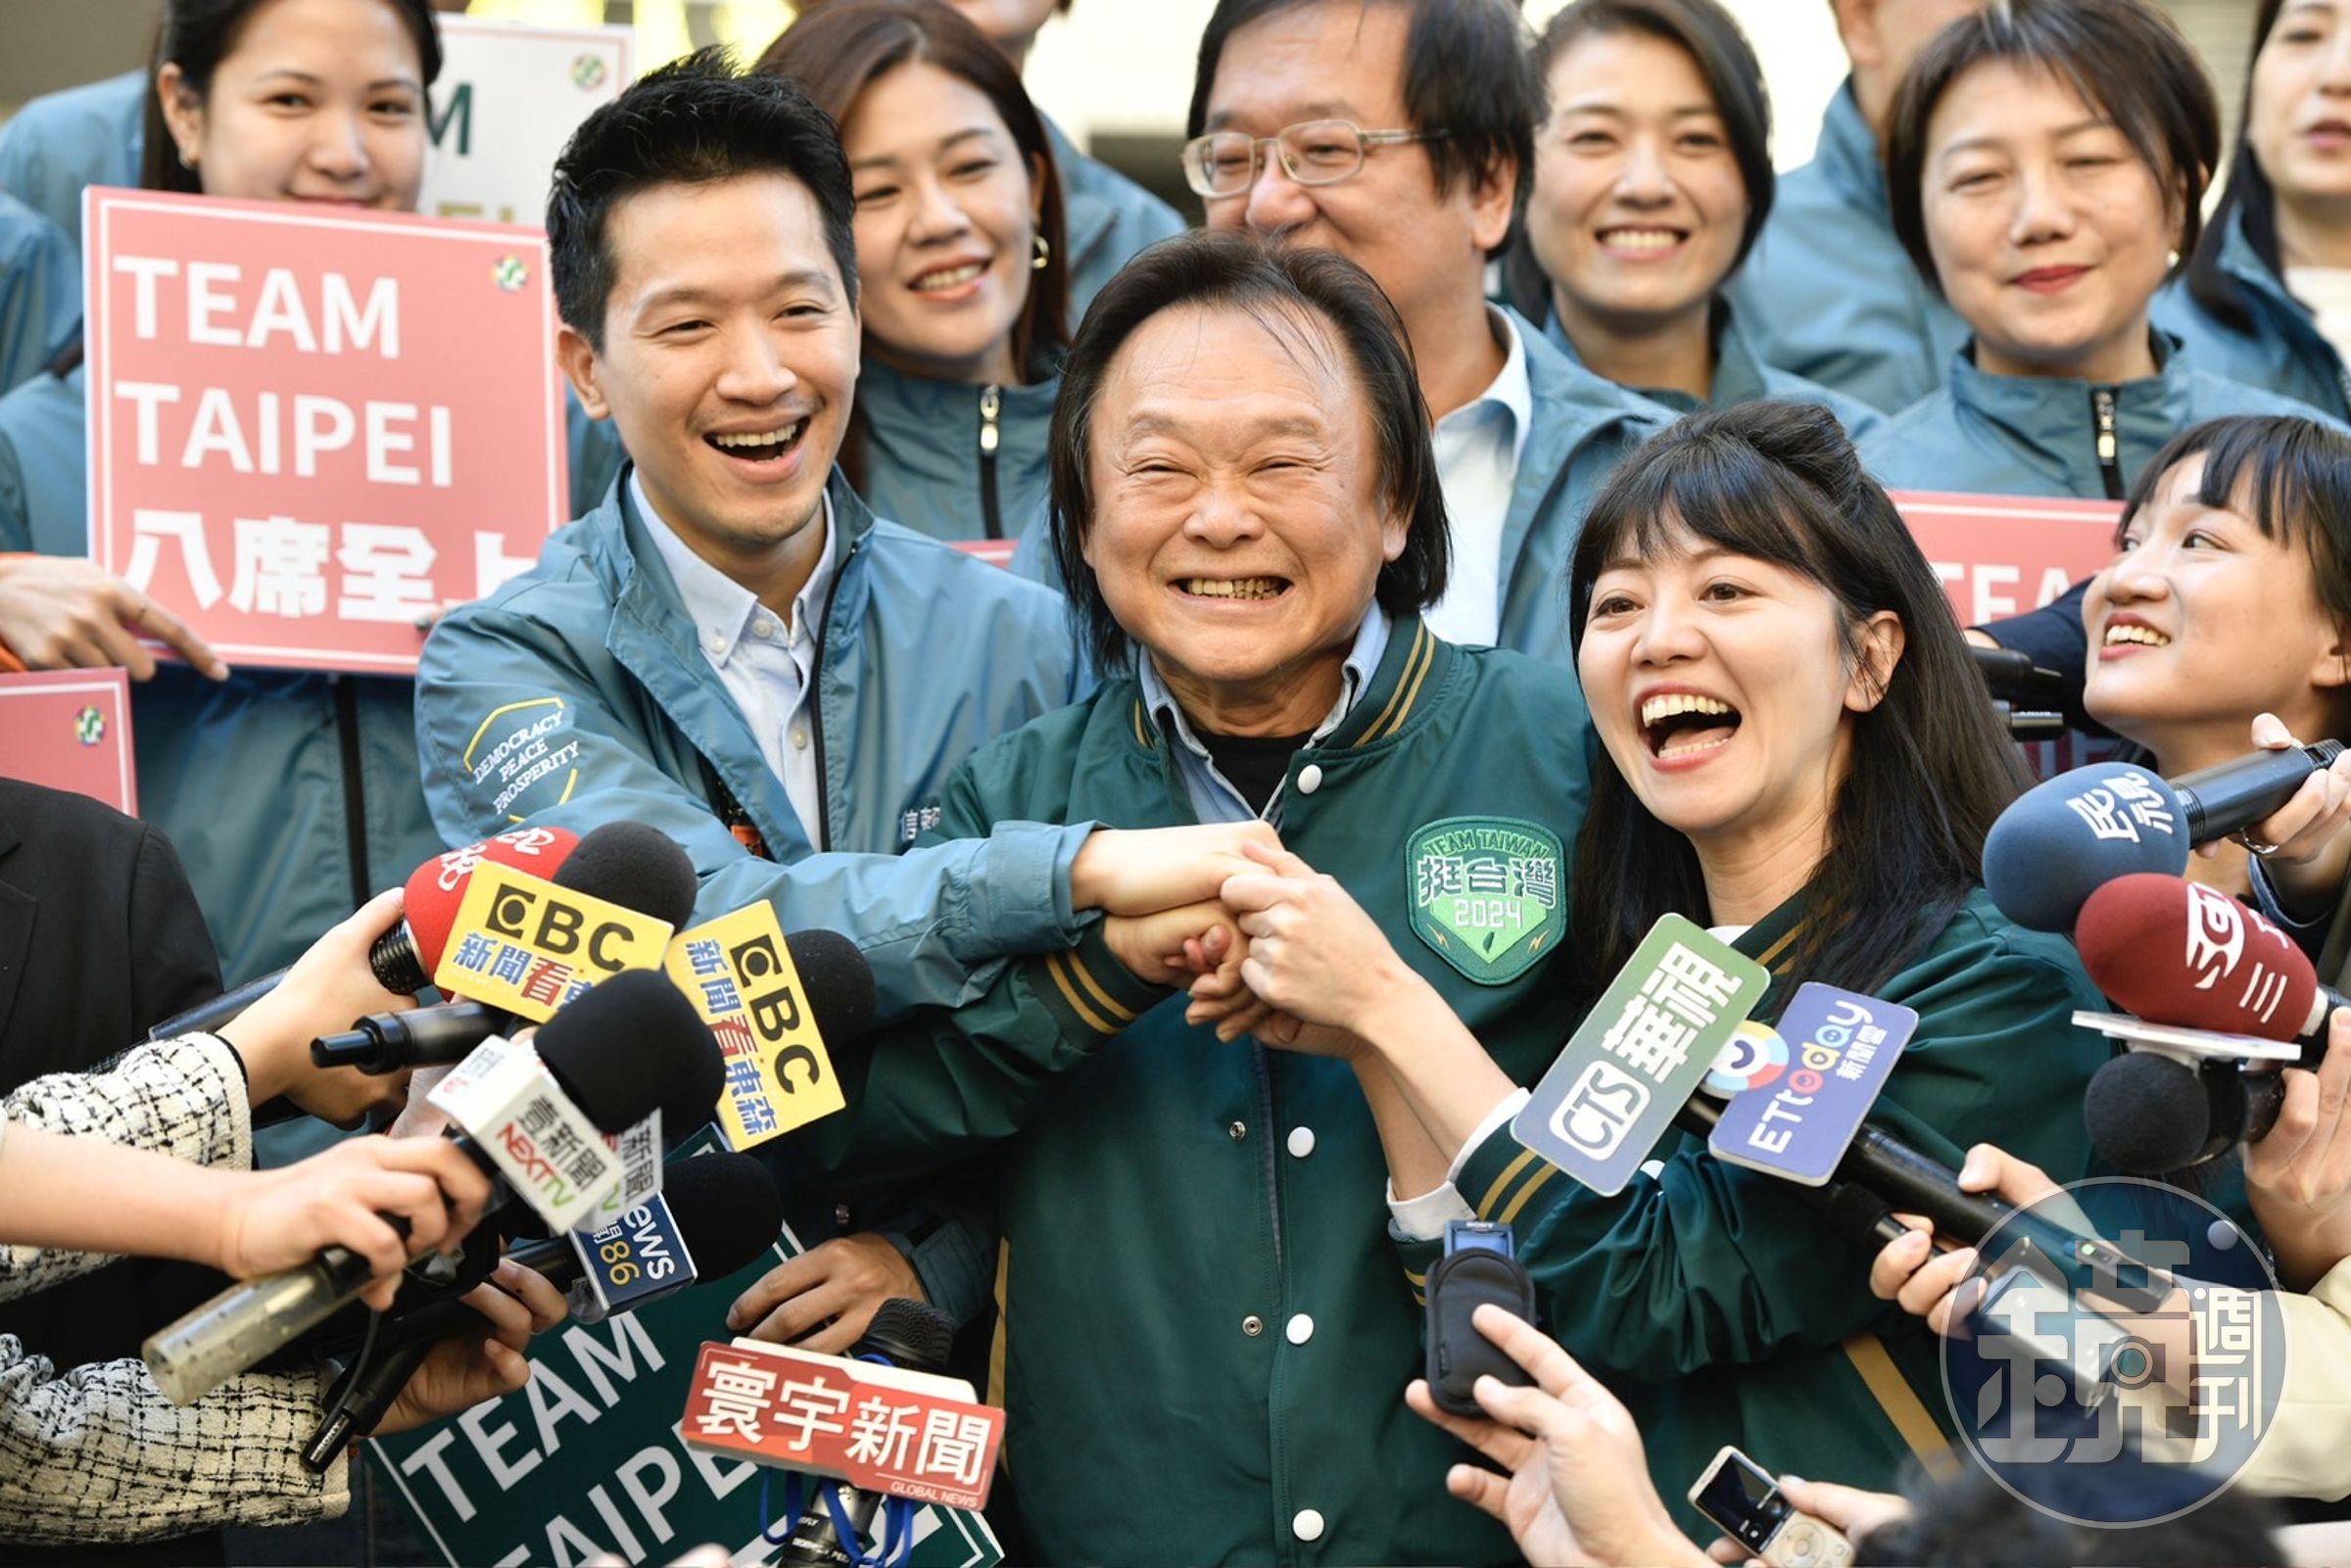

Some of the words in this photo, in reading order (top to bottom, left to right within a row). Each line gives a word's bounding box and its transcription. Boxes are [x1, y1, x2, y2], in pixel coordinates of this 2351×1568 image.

[114, 255, 400, 358] TEAM
[114, 380, 453, 488] TAIPEI
[473, 710, 564, 784] DEMOCRACY
[493, 740, 580, 815] PROSPERITY
[499, 737, 548, 783] PEACE
[1422, 829, 1475, 857] TEAM
[1476, 829, 1551, 860] TAIWAN
[2067, 771, 2173, 843] 民視
[1416, 854, 1558, 909] 挺台灣
[1454, 898, 1523, 930] 2024
[686, 939, 778, 1136] 新聞看東森
[1601, 941, 1743, 1083] 華視
[1748, 1000, 1873, 1154] ETtoday
[1836, 1025, 1889, 1082] 新聞雲
[517, 1095, 607, 1191] 壹新聞
[1561, 1068, 1646, 1150] CTS
[624, 1205, 676, 1280] ews
[401, 1309, 666, 1523] TEAM
[696, 1360, 992, 1485] 寰宇新聞
[890, 1481, 938, 1500] GLOBAL
[940, 1490, 978, 1509] NEWS
